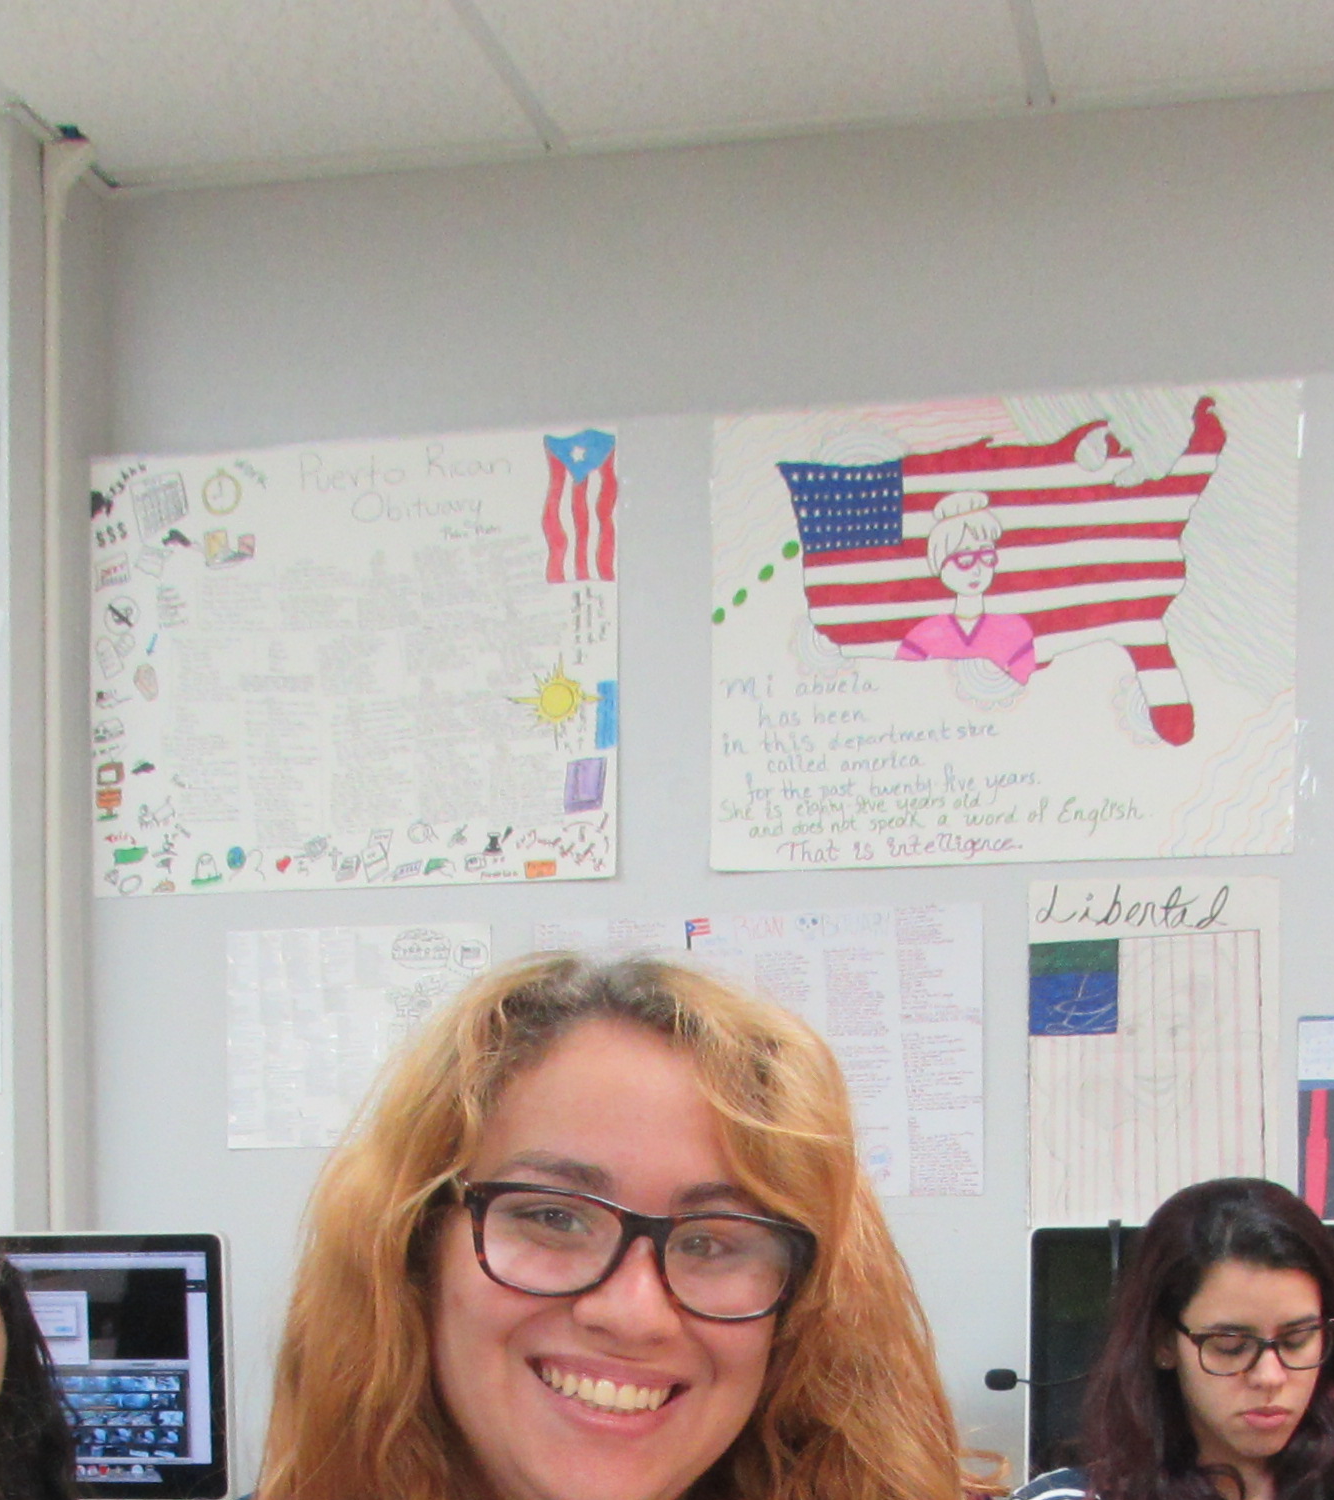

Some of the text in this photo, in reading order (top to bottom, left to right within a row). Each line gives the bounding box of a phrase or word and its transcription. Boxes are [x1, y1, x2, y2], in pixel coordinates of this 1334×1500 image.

[299, 452, 405, 494] Puerto
[426, 442, 512, 479] Rican
[351, 491, 483, 528] Obituary
[795, 671, 880, 697] abuela
[758, 702, 868, 729] has been
[722, 732, 747, 756] in
[761, 730, 815, 754] this
[829, 721, 951, 752] department
[767, 753, 925, 774] called america
[745, 771, 774, 803] for
[780, 778, 812, 801] the
[817, 777, 857, 803] past
[718, 799, 755, 823] She
[765, 799, 782, 821] is
[896, 796, 946, 815] years
[953, 793, 981, 810] old
[748, 823, 784, 840] and
[791, 820, 824, 837] does
[830, 817, 857, 834] not
[869, 808, 927, 835] speak
[937, 811, 948, 827] a
[963, 805, 1018, 827] word
[1026, 796, 1048, 824] of
[776, 838, 841, 864] That
[853, 840, 875, 862] is
[1035, 884, 1230, 930] Libertad
